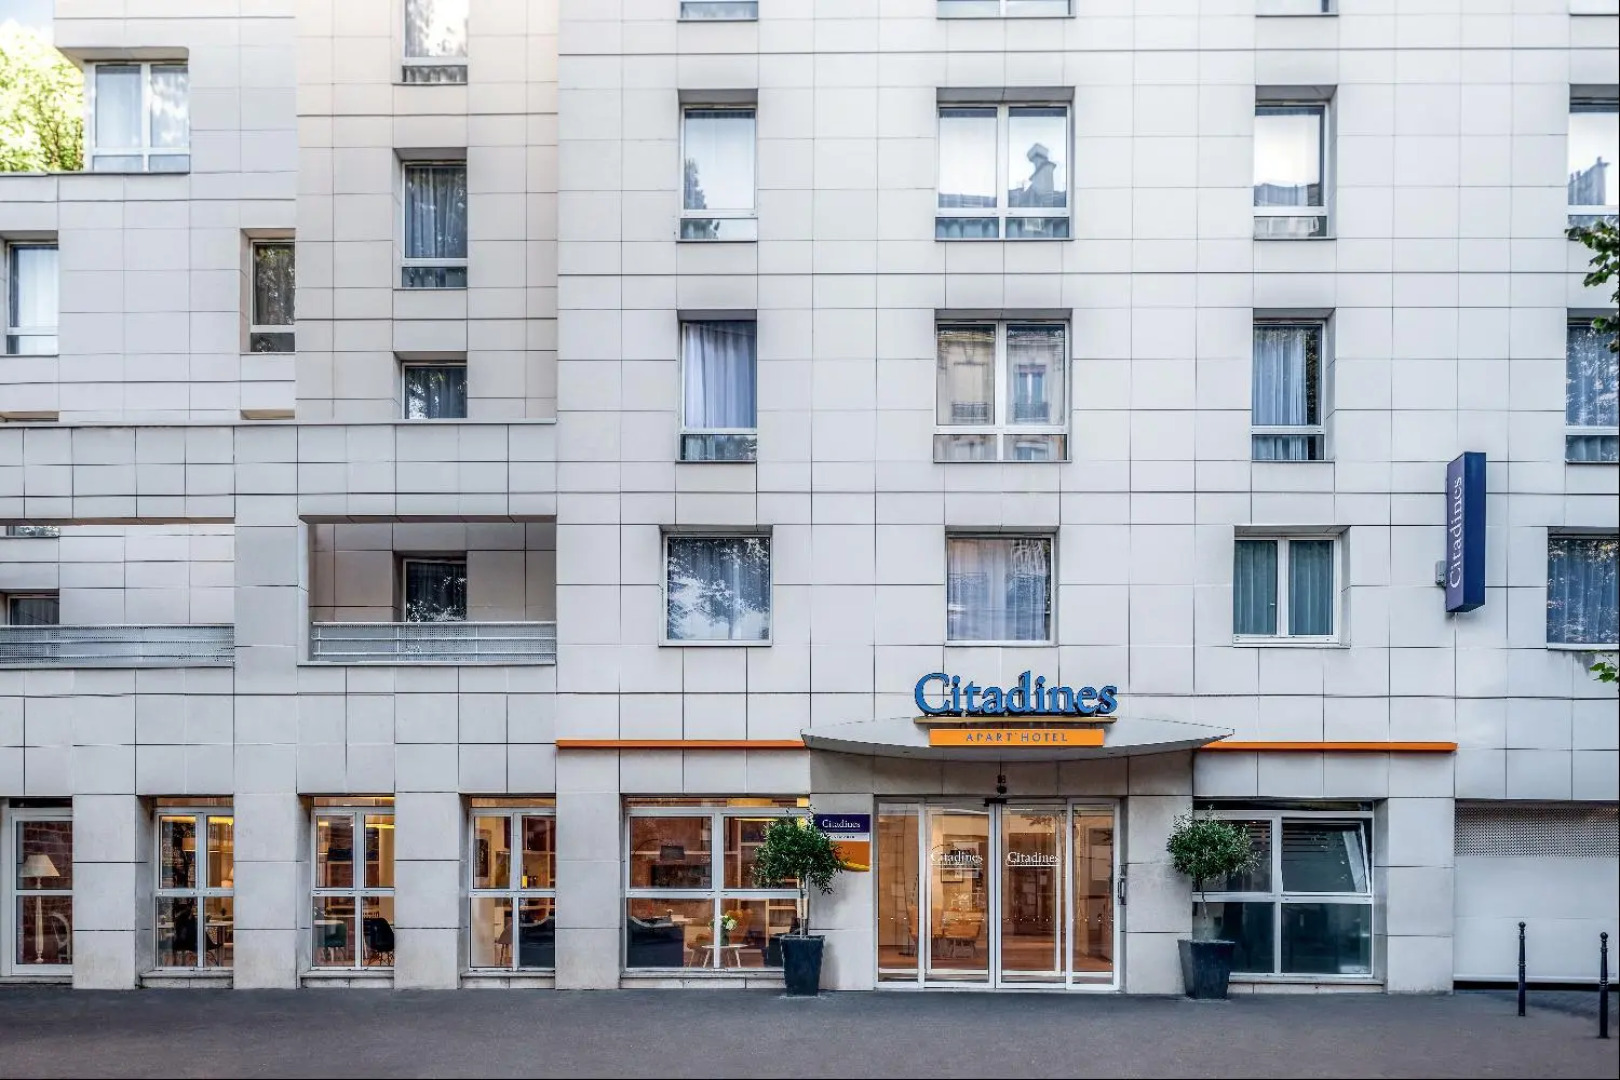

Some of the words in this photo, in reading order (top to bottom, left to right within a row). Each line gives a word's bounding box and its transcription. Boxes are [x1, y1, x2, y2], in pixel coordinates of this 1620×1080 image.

[1449, 476, 1462, 588] Citadines
[914, 670, 1118, 715] Citadines
[822, 819, 861, 828] Citadines
[931, 850, 984, 863] Citadines
[1007, 851, 1060, 864] Citadines
